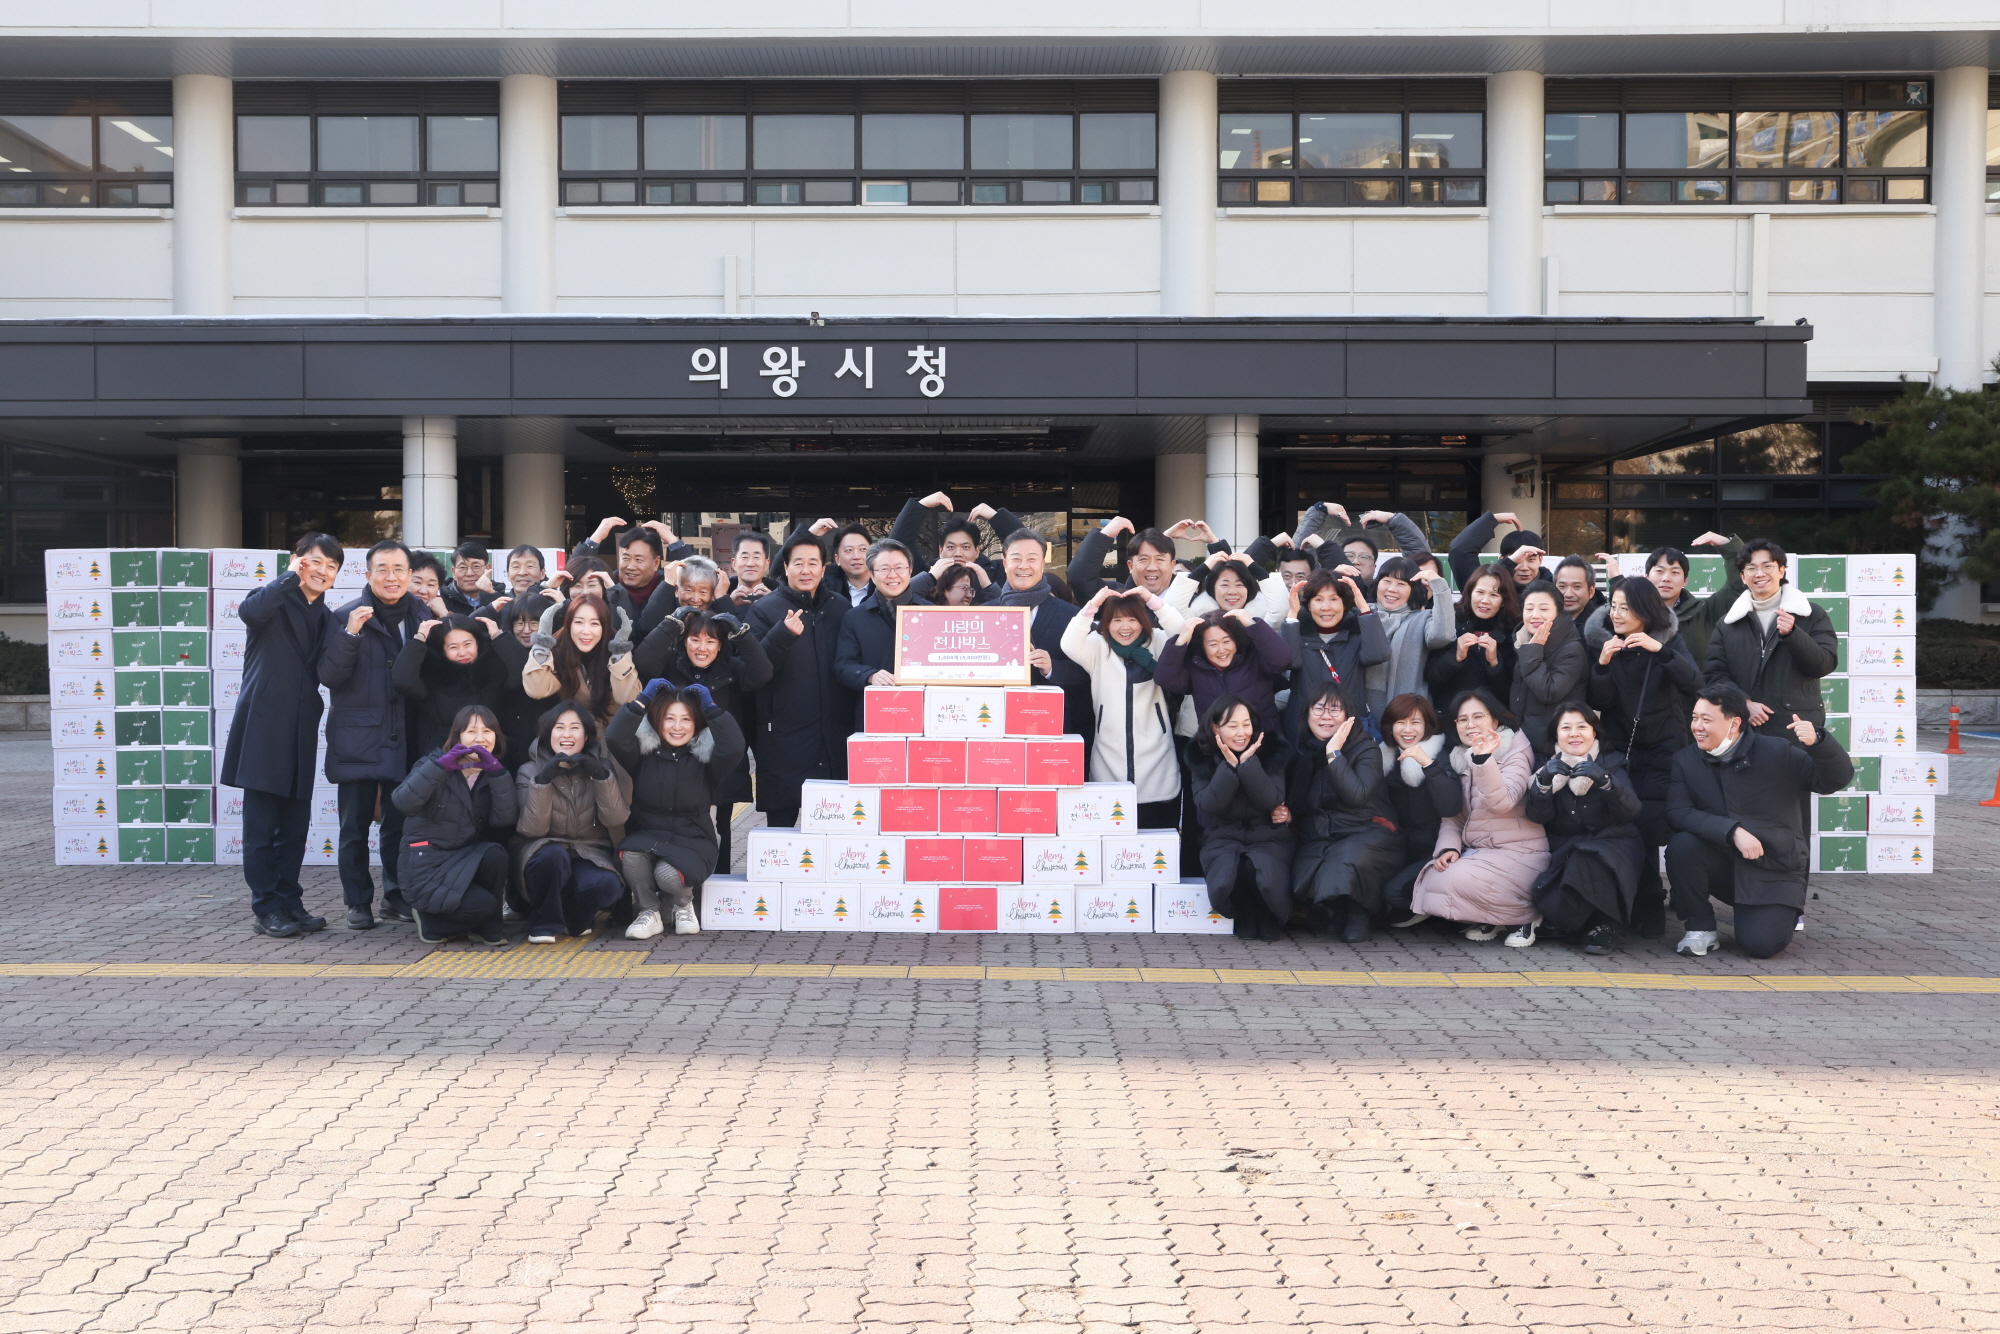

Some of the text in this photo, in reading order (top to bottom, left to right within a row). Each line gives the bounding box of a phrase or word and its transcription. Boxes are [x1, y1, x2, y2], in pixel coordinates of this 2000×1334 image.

[689, 345, 946, 397] 의왕시청
[224, 559, 247, 571] Merry
[56, 570, 81, 578] 천사박스
[225, 600, 240, 611] Mer
[1861, 606, 1884, 618] Merry
[941, 620, 984, 634] 사랑의
[933, 636, 991, 650] 천사박스
[58, 649, 83, 657] 천사박스
[1861, 645, 1883, 658] Merry
[227, 682, 239, 690] 사랑
[60, 689, 85, 697] 천사박스
[941, 704, 963, 713] 사랑의
[937, 713, 967, 722] 천사박스
[62, 728, 86, 736] 천사박스
[1863, 725, 1885, 737] Merry
[63, 767, 88, 775] 천사박스
[1891, 775, 1918, 783] 천사박스
[228, 797, 243, 808] Mer
[816, 798, 842, 812] Merry
[1074, 803, 1097, 811] 사랑의
[63, 806, 87, 814] 천사박스
[1881, 805, 1903, 817] Merry
[1070, 812, 1101, 821] 천사박스
[227, 836, 243, 847] Mer
[763, 849, 786, 858] 사랑의
[840, 847, 867, 862] Merry
[1038, 849, 1064, 862] Merry
[1116, 848, 1142, 861] Merry
[1877, 854, 1903, 862] 천사박스
[759, 859, 790, 867] 천사박스
[718, 897, 740, 906] 사랑의
[797, 898, 820, 907] 사랑의
[874, 896, 901, 909] Merry
[1012, 897, 1038, 910] Merry
[1089, 896, 1115, 910] Merry
[1171, 900, 1195, 908] 사랑의
[714, 907, 744, 916] 천사박스
[794, 908, 824, 917] 천사박스
[1167, 909, 1198, 918] 천사박스
